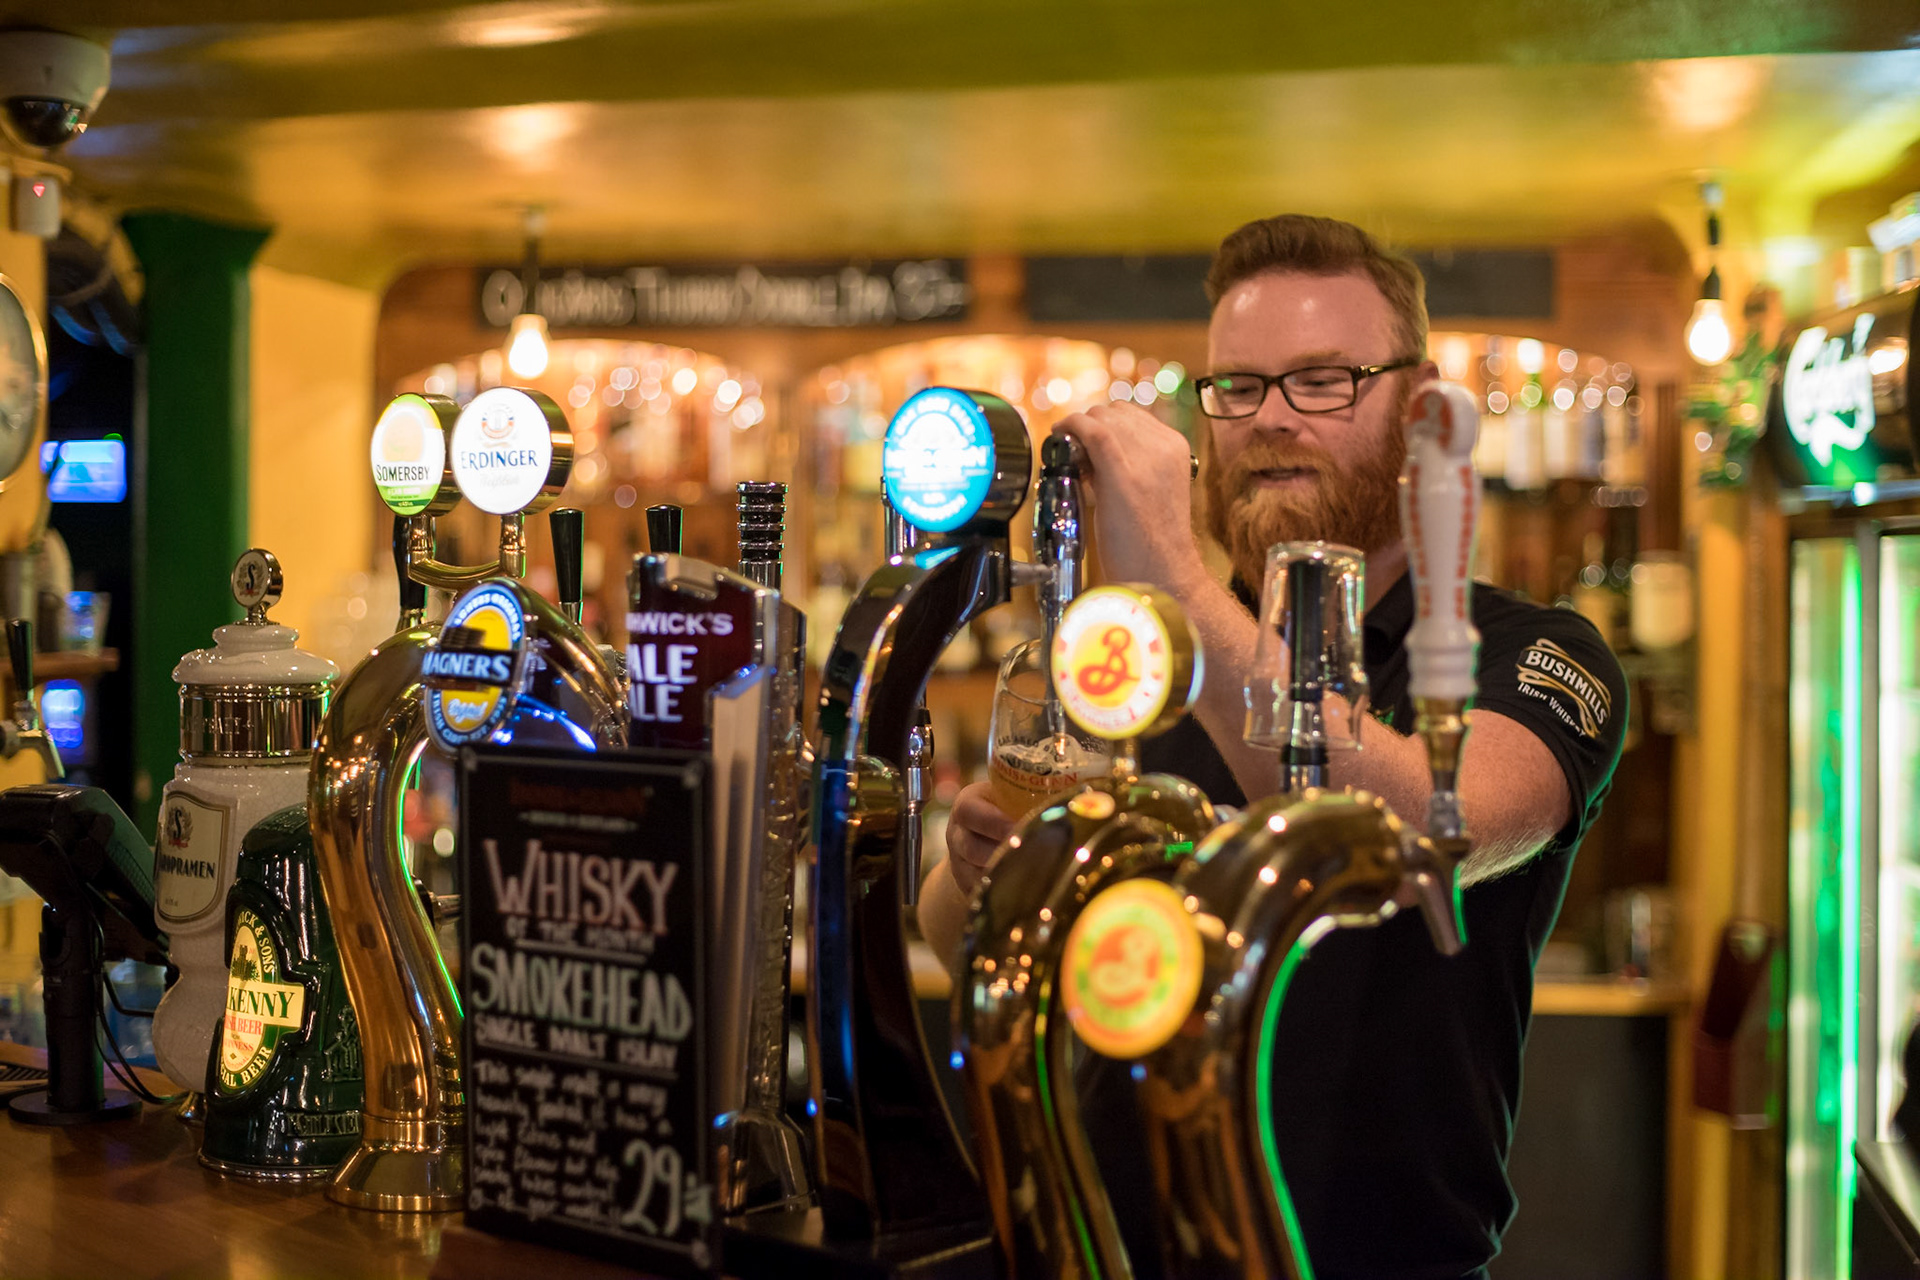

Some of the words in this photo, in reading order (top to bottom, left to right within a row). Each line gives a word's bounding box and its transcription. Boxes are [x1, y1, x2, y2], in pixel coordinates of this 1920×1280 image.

[376, 464, 430, 482] SOMERSBY
[461, 450, 538, 470] ERDINGER
[1517, 682, 1548, 700] IRISH
[1525, 650, 1607, 725] BUSHMILLS
[483, 838, 678, 936] WHISKY
[255, 925, 265, 939] &
[258, 937, 276, 974] SONS
[227, 986, 296, 1020] KENNY
[471, 942, 693, 1042] SMOKEHEAD
[238, 1017, 263, 1036] BEER
[240, 1046, 273, 1085] BEER
[622, 1138, 682, 1238] 29
